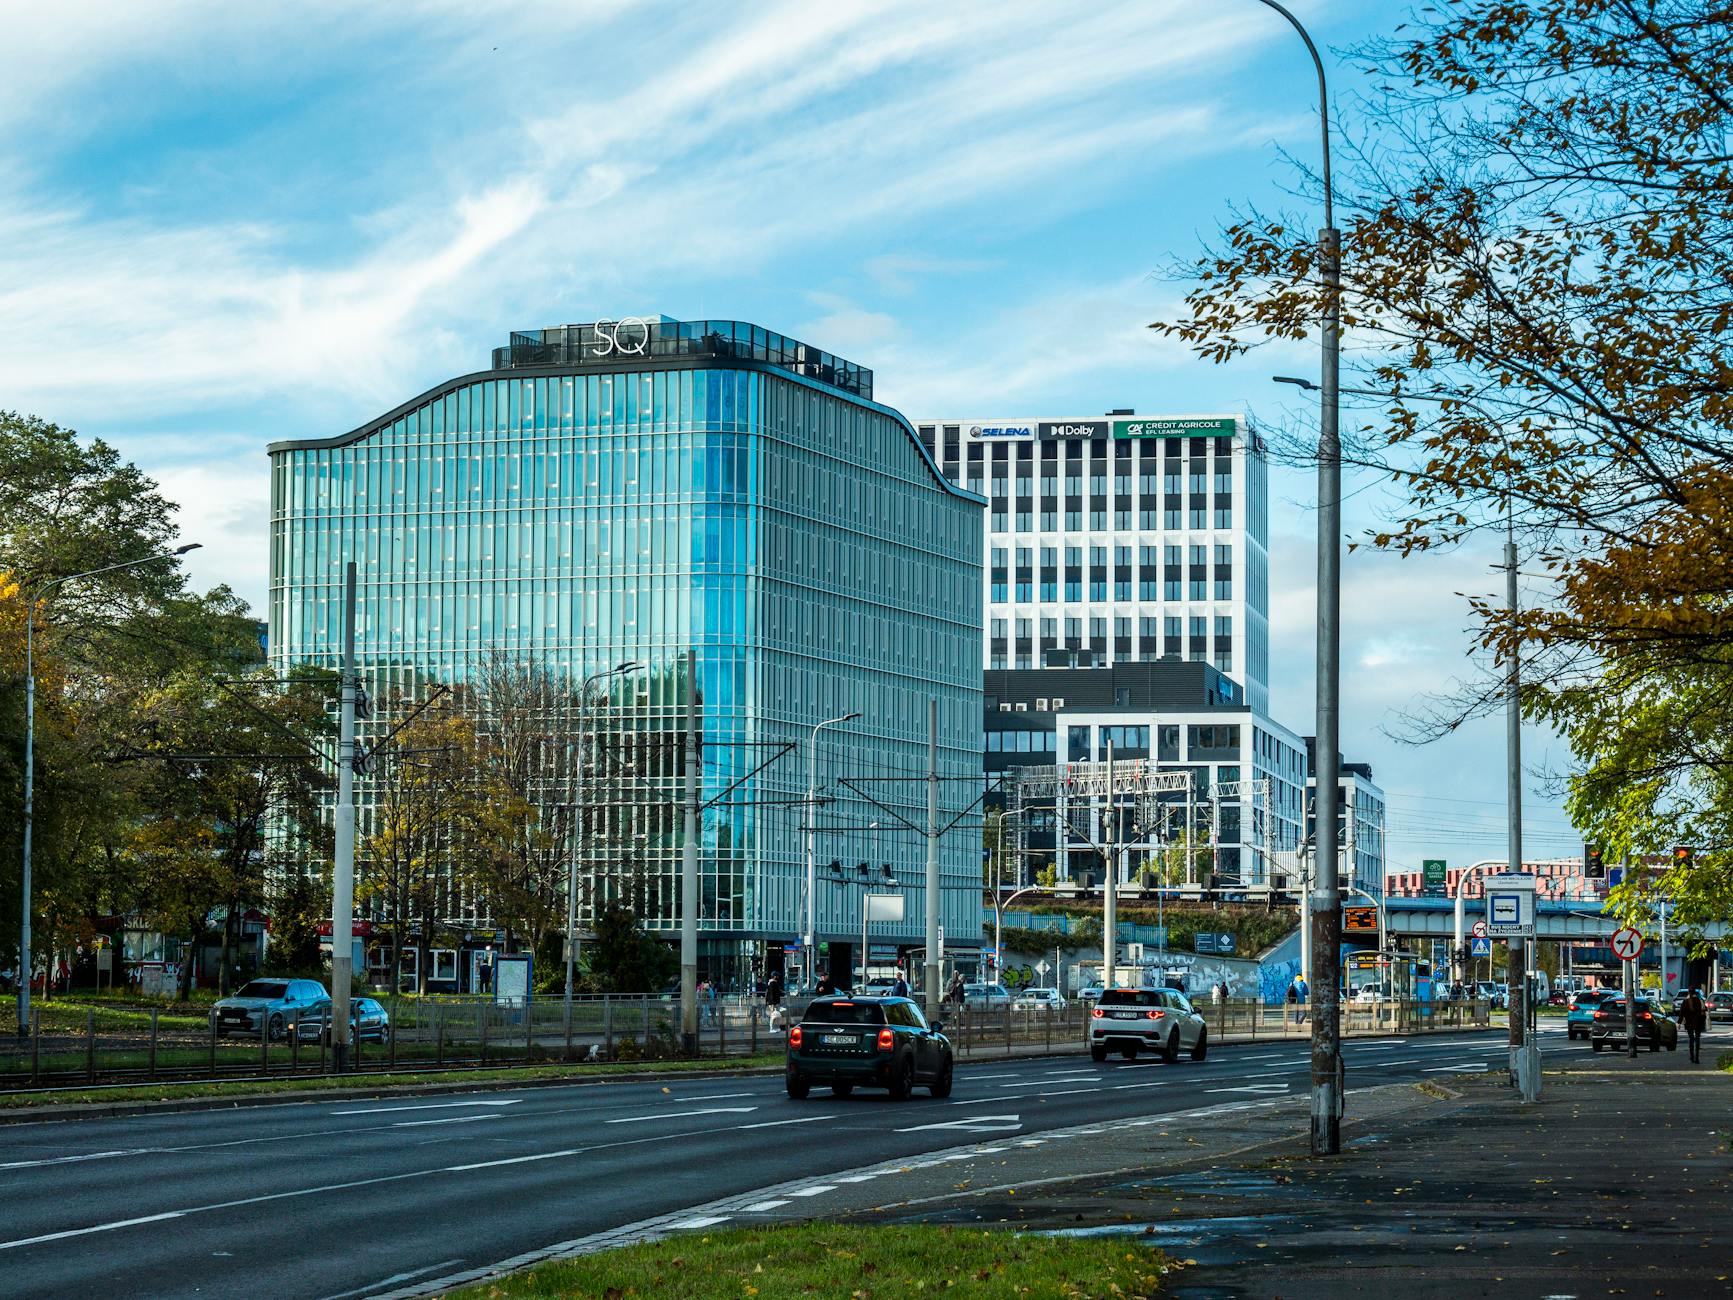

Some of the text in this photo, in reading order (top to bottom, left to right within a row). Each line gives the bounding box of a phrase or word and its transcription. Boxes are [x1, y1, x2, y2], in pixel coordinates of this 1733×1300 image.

[592, 316, 648, 355] SQ
[981, 427, 1031, 437] SELENA
[1065, 425, 1095, 437] Dolby
